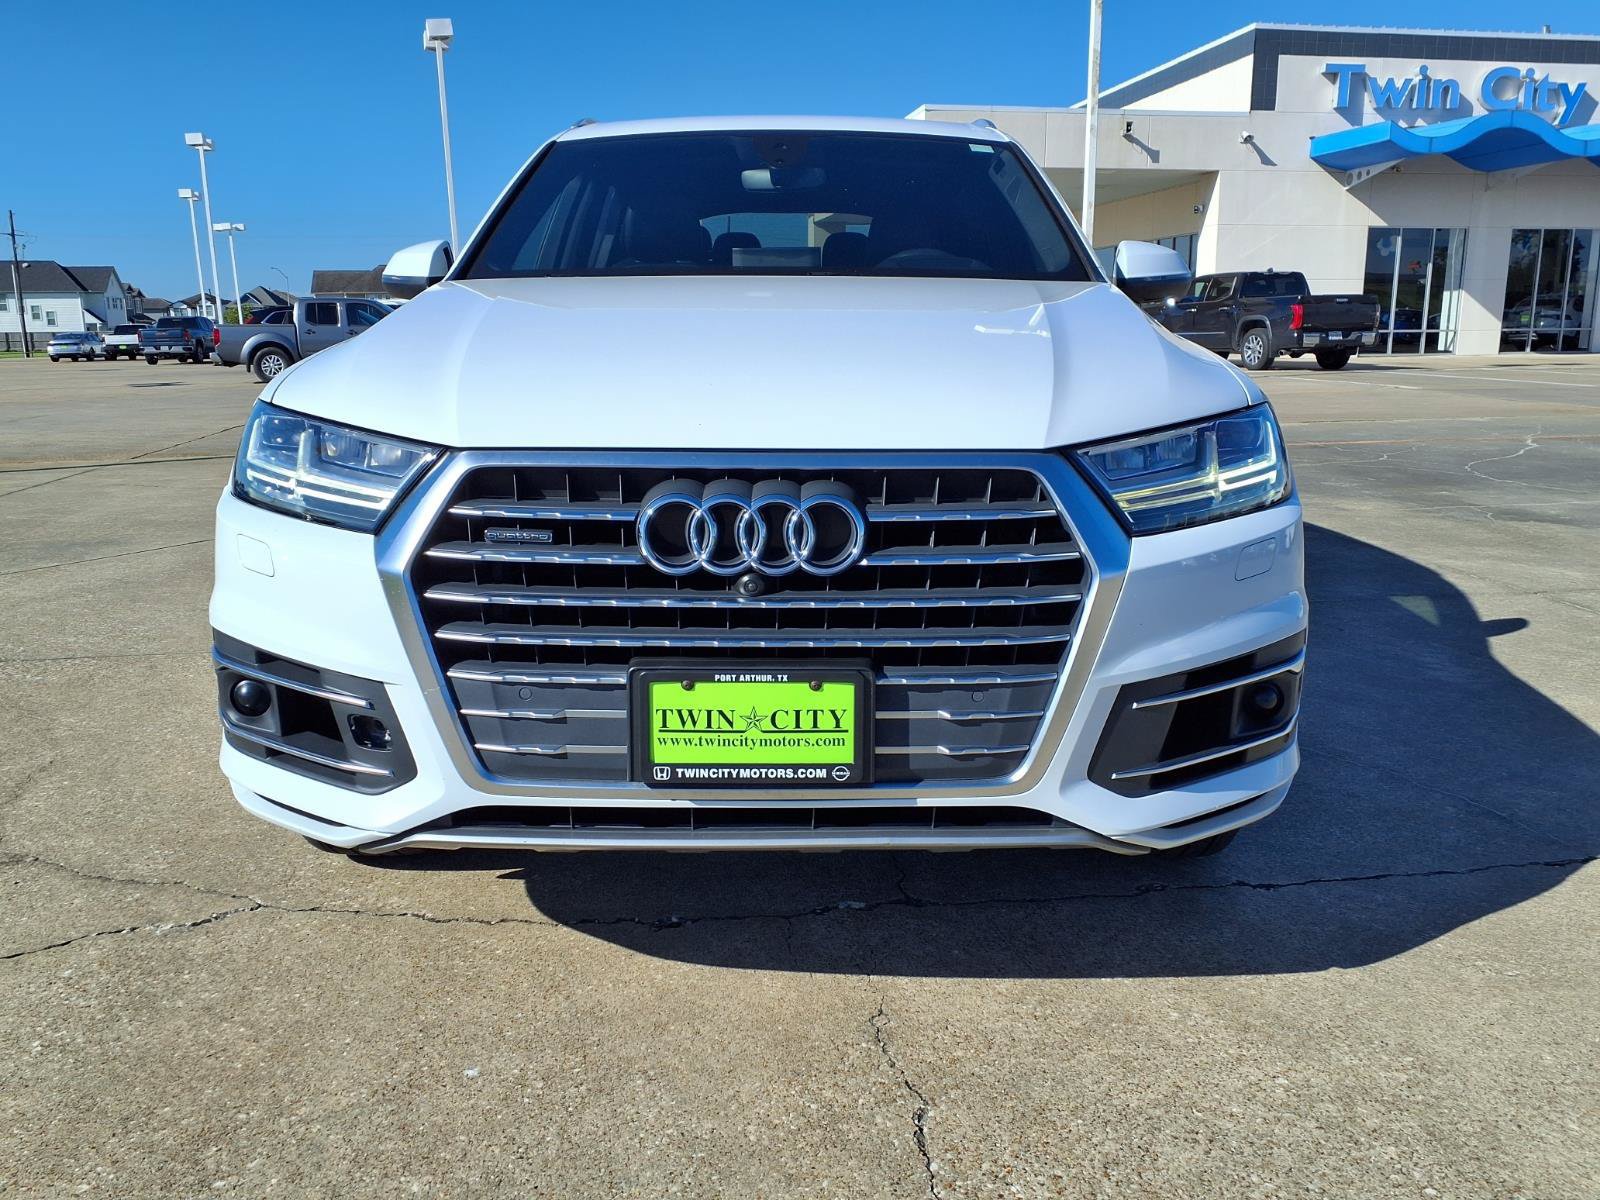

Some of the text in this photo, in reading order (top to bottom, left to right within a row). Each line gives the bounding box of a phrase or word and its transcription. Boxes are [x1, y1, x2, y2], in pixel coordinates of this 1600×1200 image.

[1321, 63, 1587, 126] Twin City
[714, 674, 737, 682] PORT
[777, 674, 789, 682] TX
[655, 708, 847, 729] TWIN CITY
[657, 735, 846, 750] www.twincitymotors.com
[675, 767, 827, 779] TWINCITYMOTORS.COM
